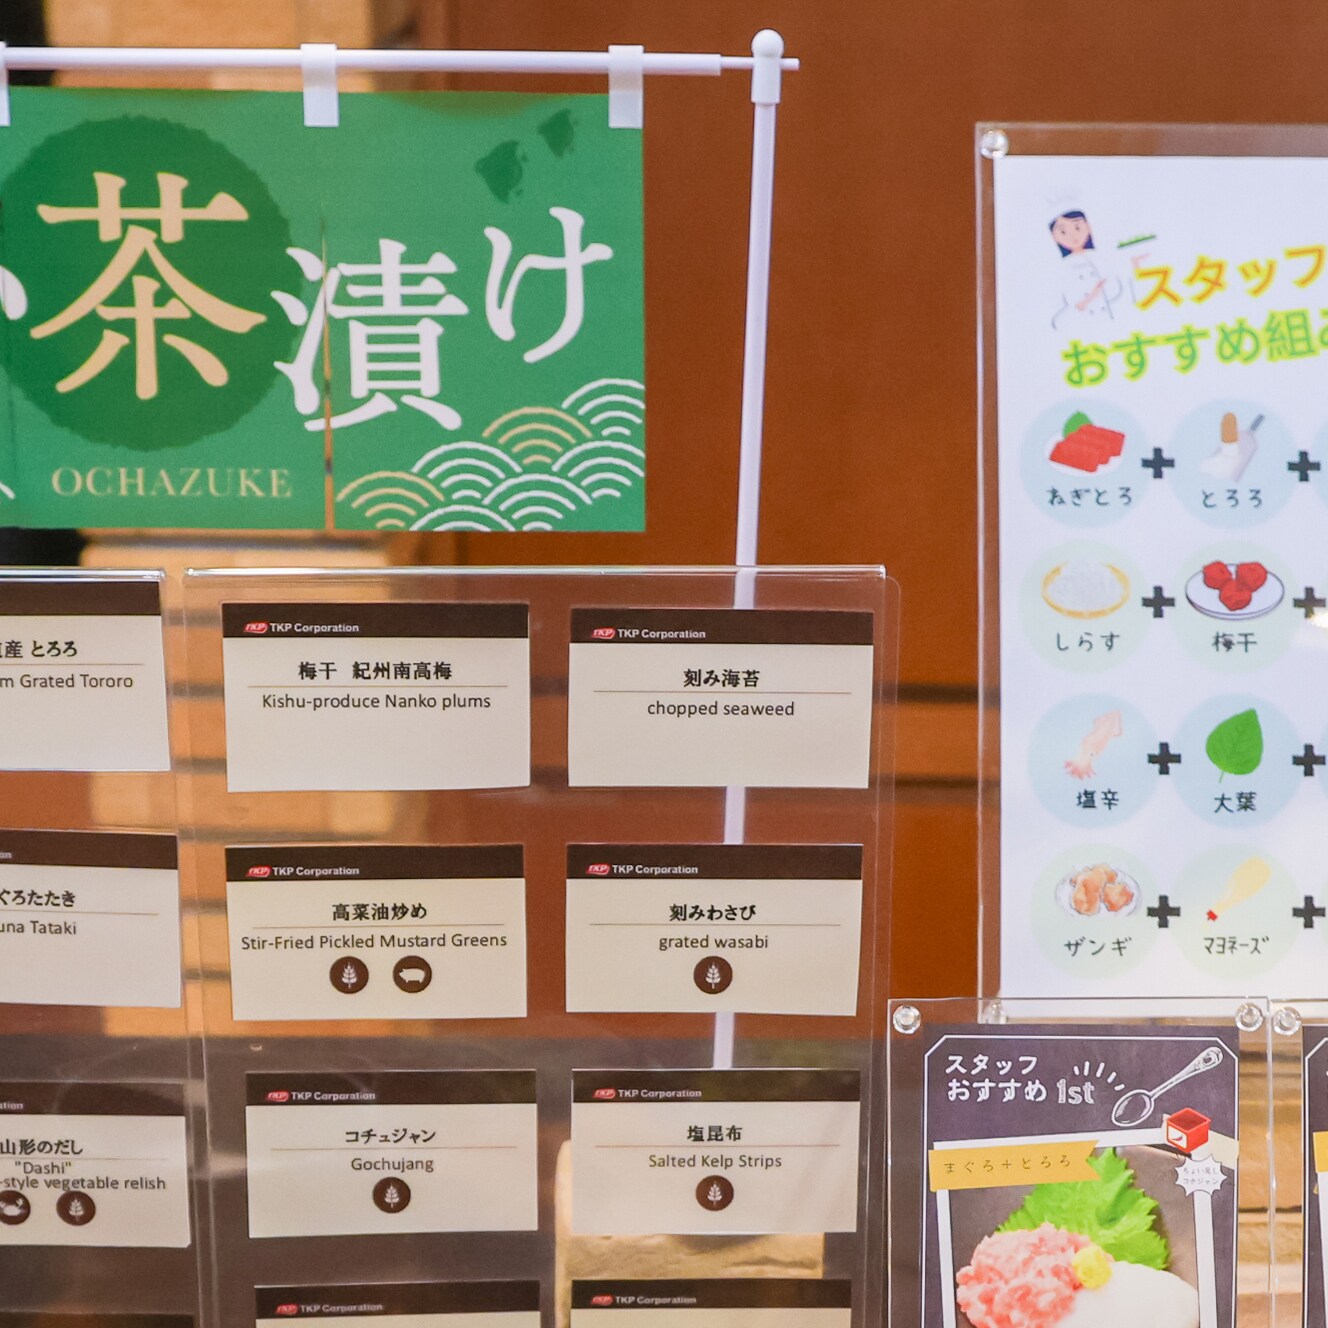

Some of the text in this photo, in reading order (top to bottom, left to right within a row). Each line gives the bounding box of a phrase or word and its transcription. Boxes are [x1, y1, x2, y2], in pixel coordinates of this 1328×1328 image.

[52, 468, 291, 497] OCHAZUKE
[1049, 487, 1131, 506] ねぎとろ
[1203, 489, 1262, 508] とろろ
[269, 622, 359, 634] TKP Corporation
[618, 629, 705, 639] TKP Corporation
[32, 641, 77, 657] とろろ
[1057, 632, 1119, 651] しらす
[1213, 633, 1256, 652] 梅干
[299, 662, 336, 680] 梅干
[684, 669, 759, 687] 刻み海苔
[20, 674, 74, 688] Grated
[80, 674, 133, 687] Tororo
[263, 694, 490, 710] Kishu-produce Nanko plums
[648, 701, 794, 717] chopped seaweed
[1077, 790, 1118, 809] 塩辛
[1215, 792, 1256, 812] 大葉
[273, 867, 359, 876] TKP Corporation
[612, 865, 698, 875] TKP Corporation
[333, 903, 426, 920] 高菜油炒め
[670, 904, 755, 921] 刻みわさび
[30, 921, 76, 934] Tataki
[242, 934, 506, 949] Stir-Fried Pickled Mustard Greens
[659, 936, 767, 951] grated wasabi
[1064, 937, 1131, 956] ザンギ
[946, 1054, 1037, 1074] スタッフ
[948, 1075, 1097, 1104] おすすめ 1st
[346, 1128, 435, 1143] コチュジャン
[688, 1126, 742, 1141] 塩昆布
[0, 1139, 82, 1155] 山形のだし
[15, 1161, 72, 1175] "Dashi"
[351, 1158, 433, 1172] Gochujang
[649, 1155, 781, 1169] Salted Kelp Strips
[45, 1174, 119, 1191] vegetable
[125, 1177, 165, 1189] relish
